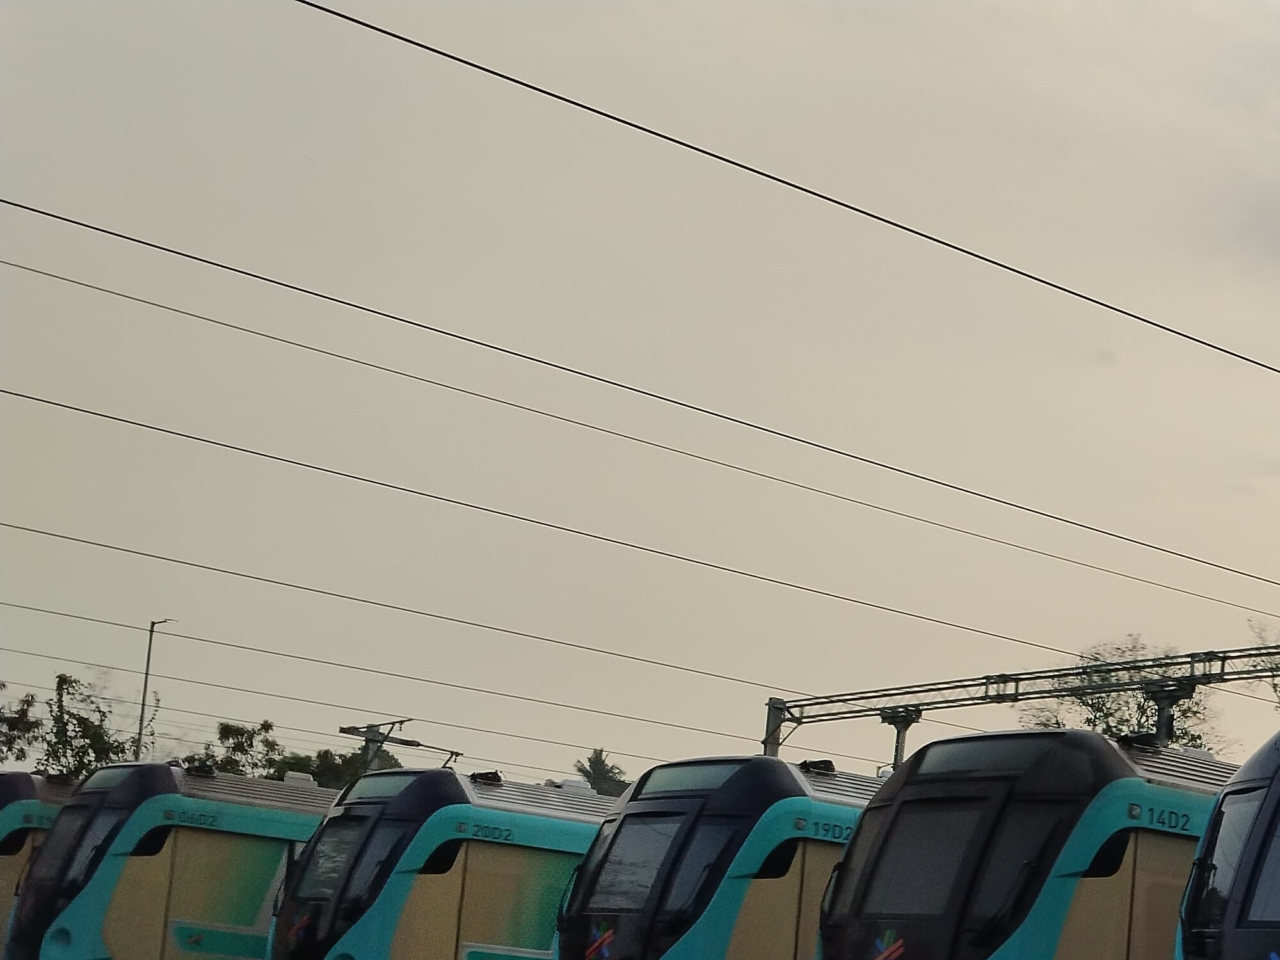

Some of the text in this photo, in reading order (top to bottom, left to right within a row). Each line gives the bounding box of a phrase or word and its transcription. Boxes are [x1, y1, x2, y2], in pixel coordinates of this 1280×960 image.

[1148, 807, 1190, 832] 14D2
[472, 823, 513, 841] 20D2
[813, 821, 854, 841] 19D2
